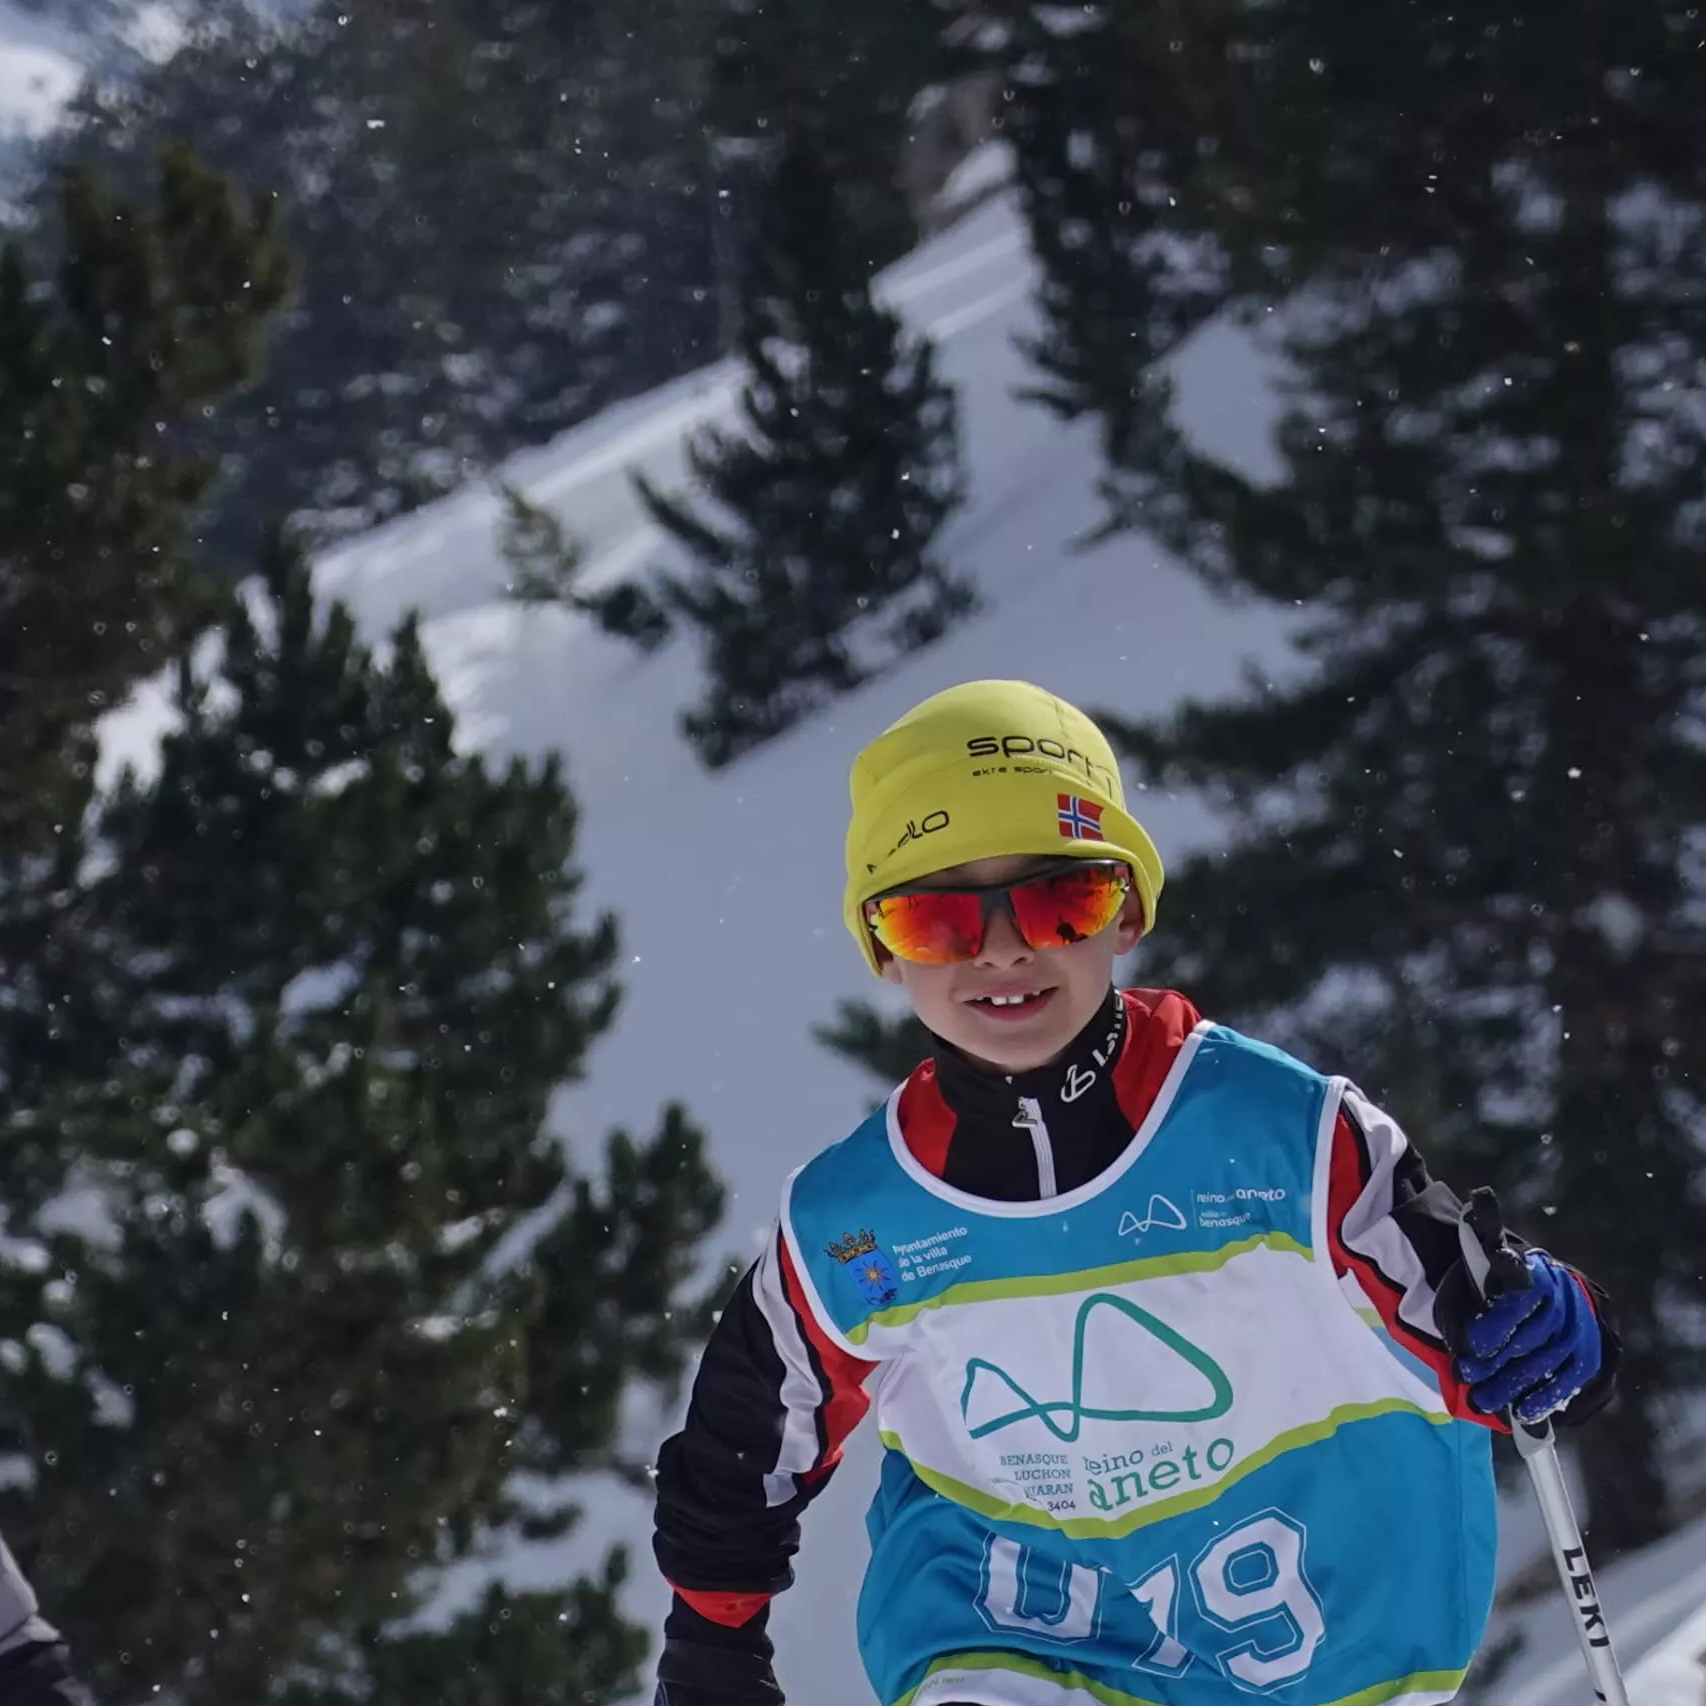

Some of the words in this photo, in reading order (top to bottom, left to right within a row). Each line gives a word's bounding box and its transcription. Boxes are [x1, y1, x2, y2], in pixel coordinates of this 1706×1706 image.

[923, 1246, 948, 1261] villa
[901, 1270, 916, 1282] de
[916, 1254, 973, 1277] Benasque
[1151, 1441, 1174, 1457] del
[1014, 1467, 1071, 1481] LUCHON
[1086, 1437, 1235, 1512] aneto
[1047, 1499, 1077, 1512] 3404
[1562, 1546, 1611, 1648] LEKI
